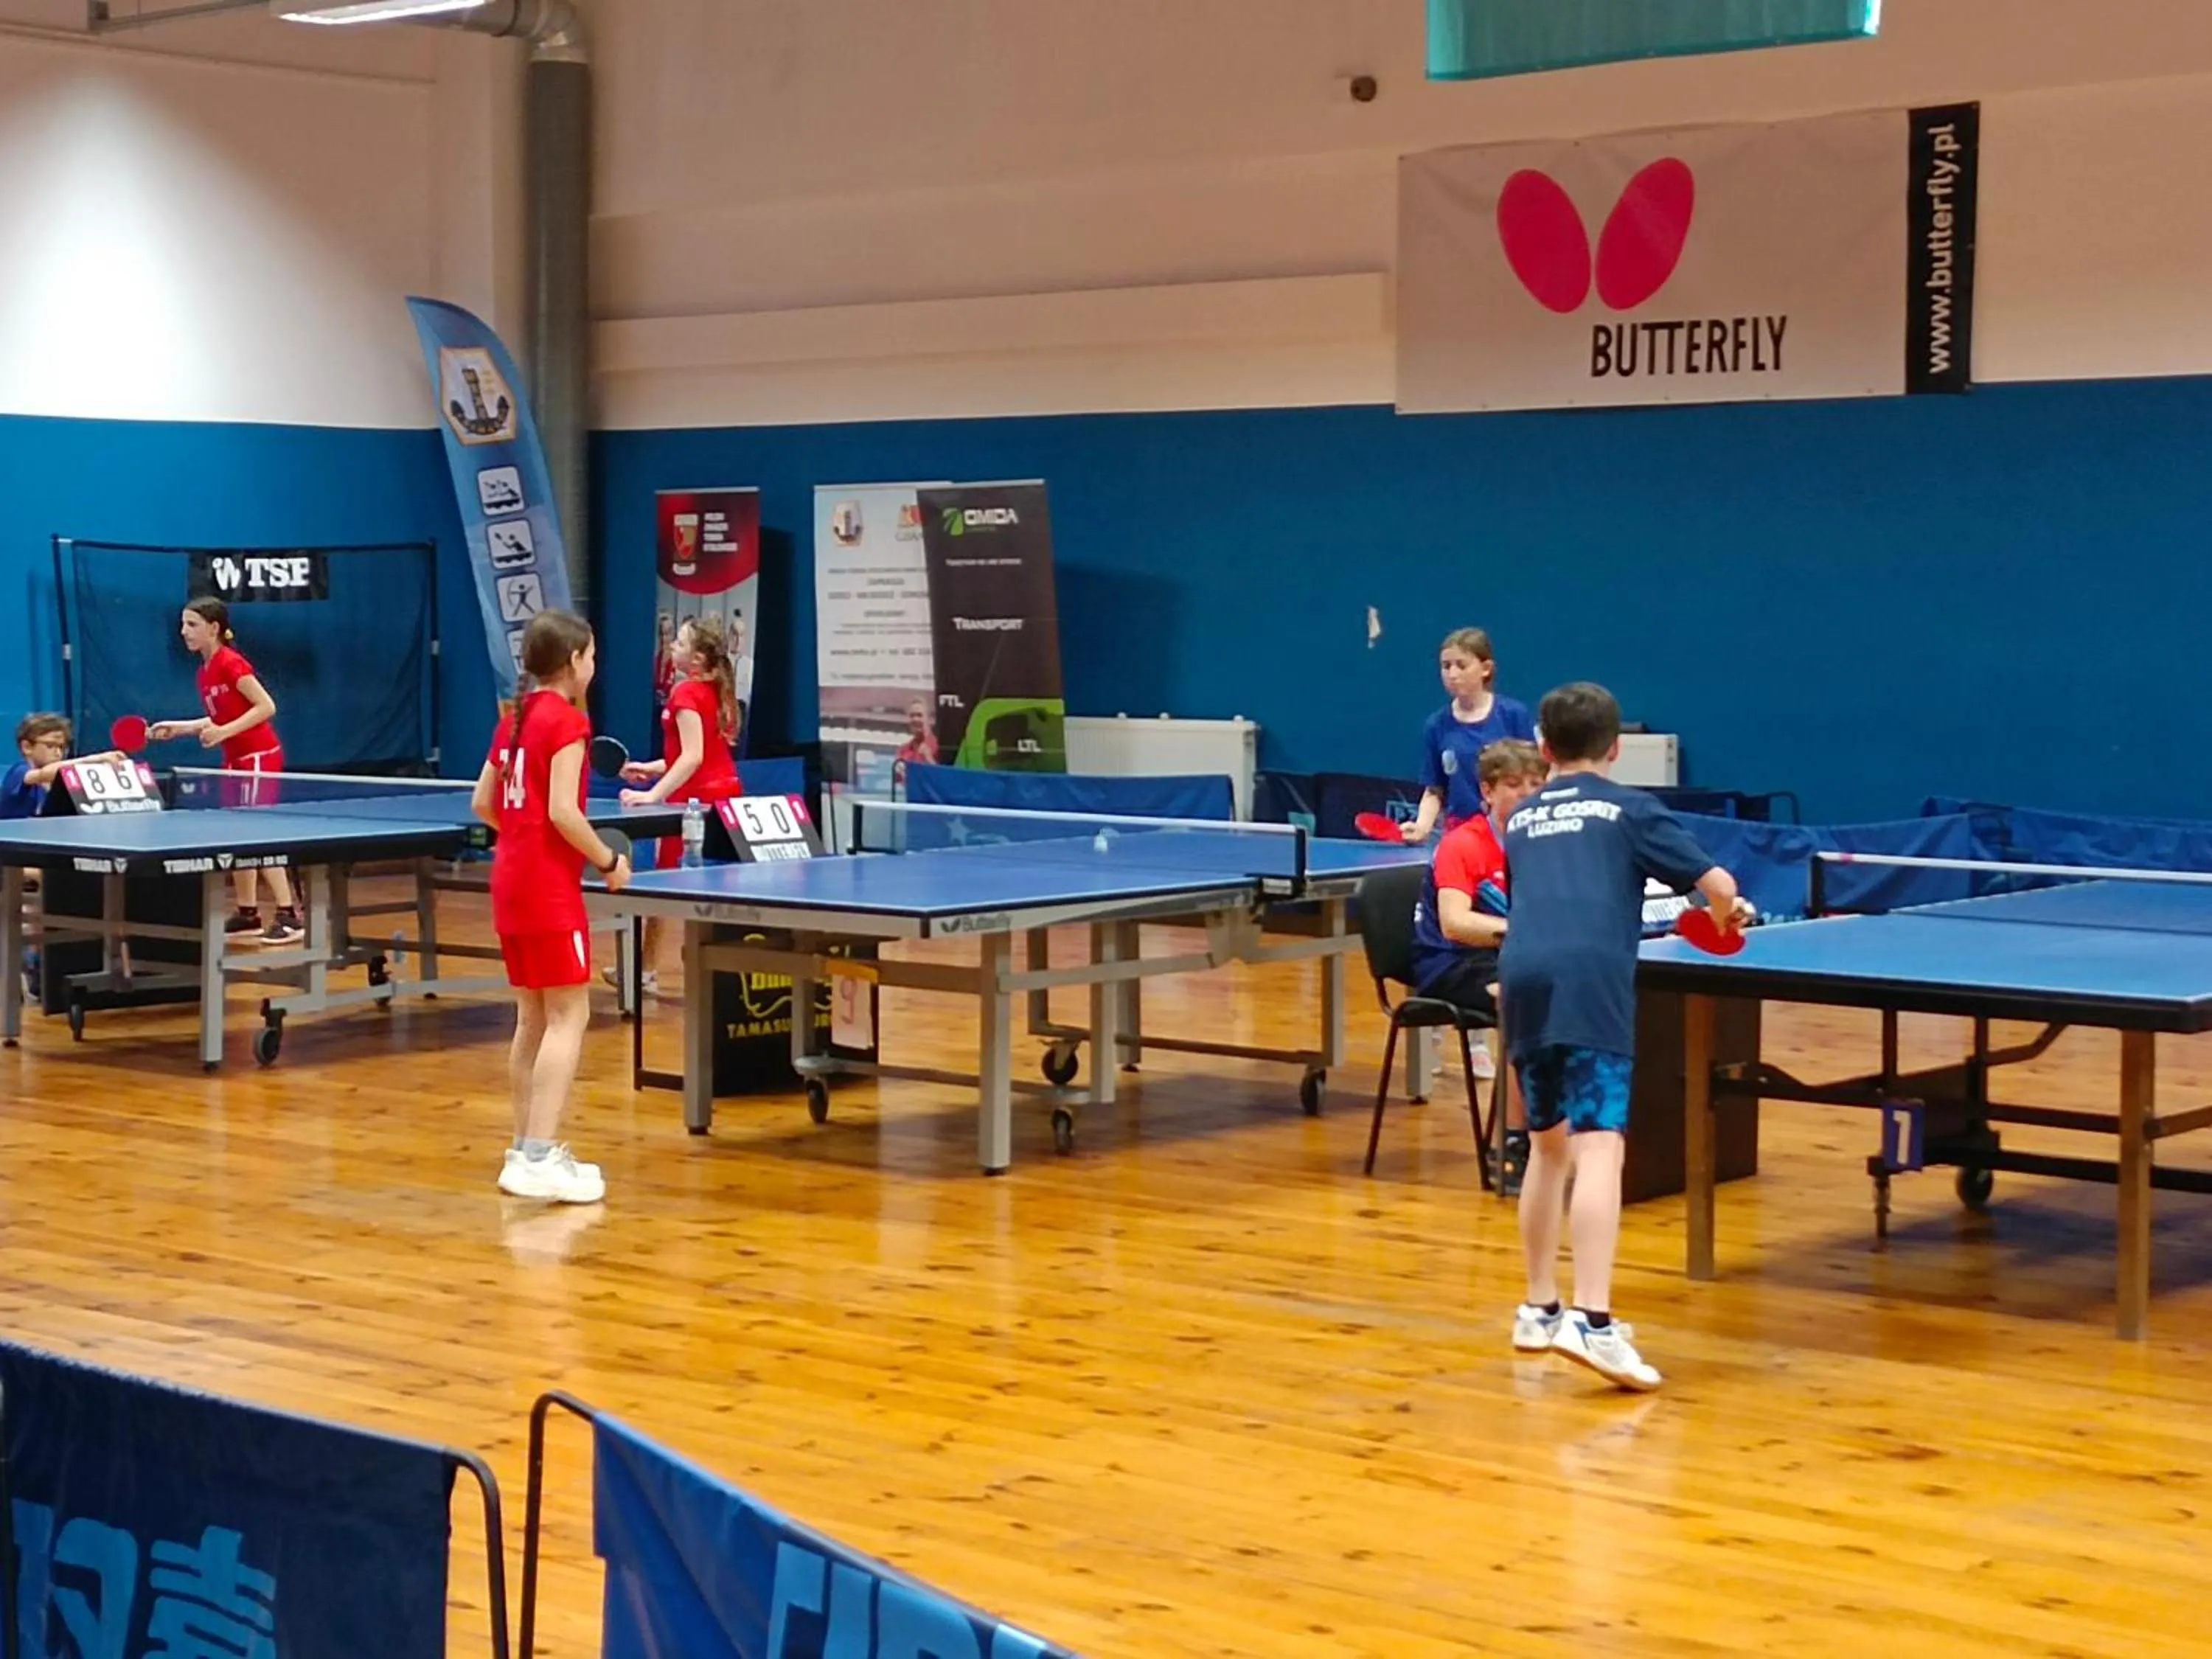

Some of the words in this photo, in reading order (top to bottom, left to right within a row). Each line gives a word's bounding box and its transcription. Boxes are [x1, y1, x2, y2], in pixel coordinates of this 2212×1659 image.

[1925, 122, 1961, 374] www.butterfly.pl
[1591, 314, 1787, 378] BUTTERFLY
[939, 695, 965, 708] FTL
[1018, 739, 1041, 753] LTL
[86, 768, 105, 794] 8
[114, 765, 132, 790] 6
[722, 804, 735, 825] 1
[743, 803, 763, 835] 5
[771, 802, 790, 834] 0
[1893, 1109, 1912, 1164] 1
